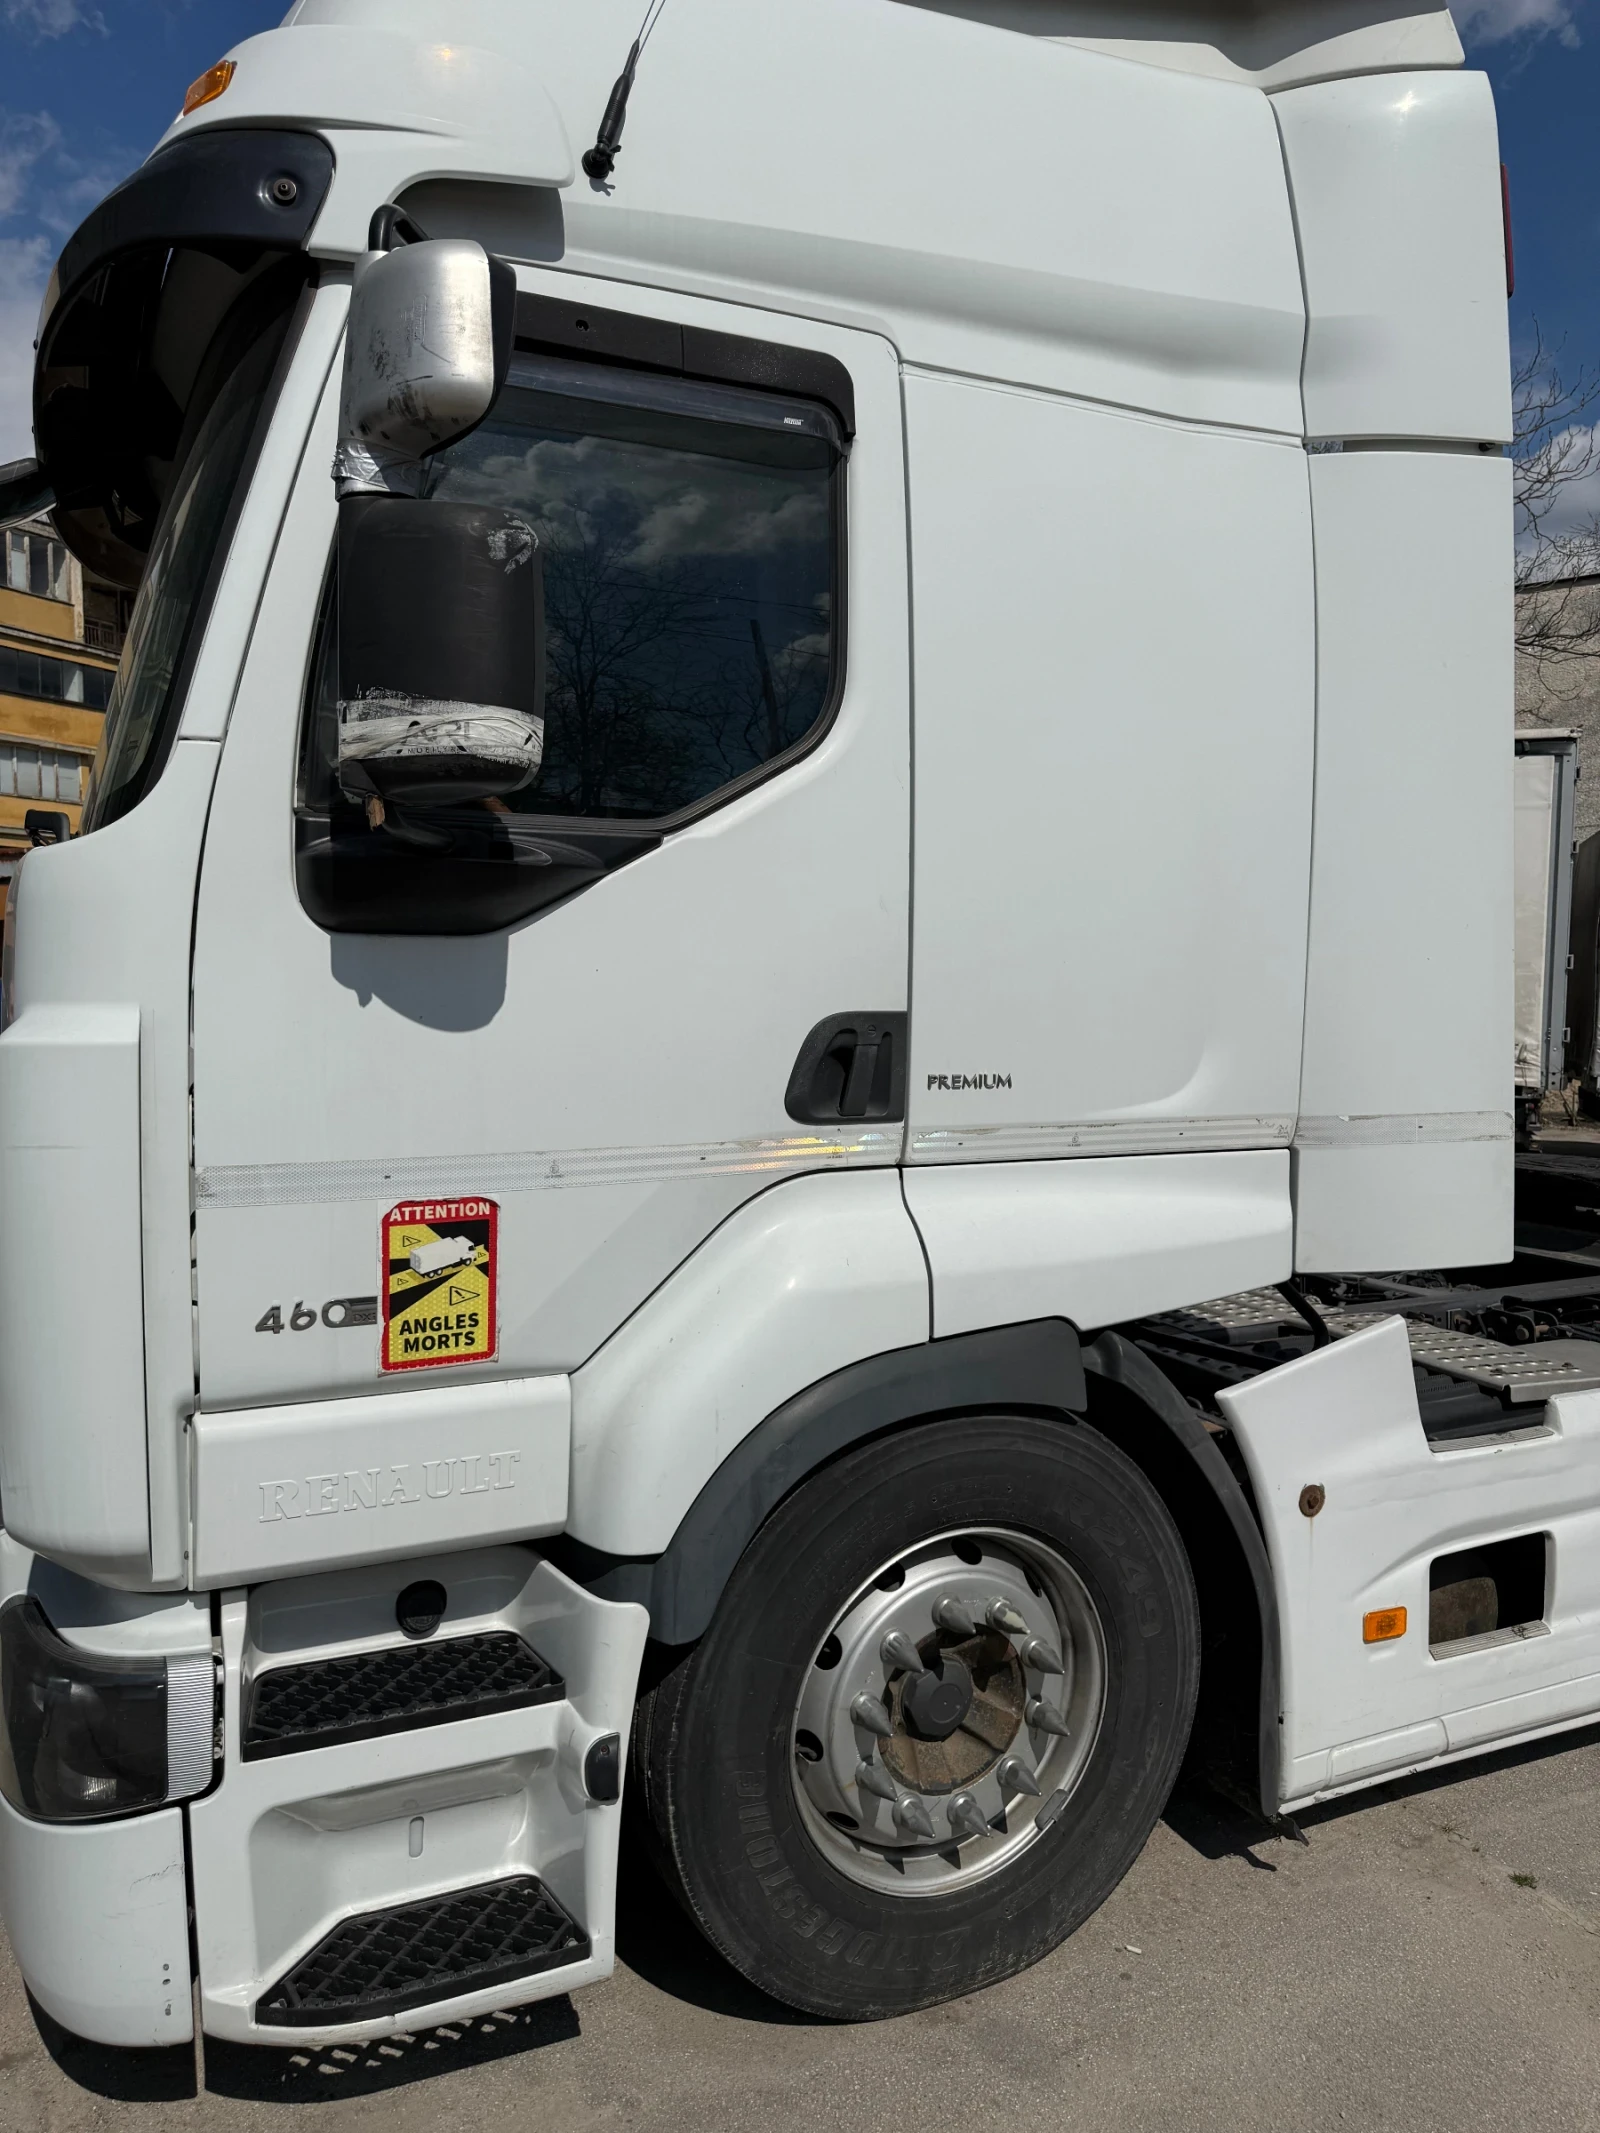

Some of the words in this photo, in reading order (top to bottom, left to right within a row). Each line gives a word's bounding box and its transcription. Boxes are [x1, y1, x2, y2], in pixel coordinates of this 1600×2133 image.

[927, 1073, 1012, 1091] PREMIUM
[389, 1202, 490, 1222] ATTENTION
[255, 1299, 350, 1335] 460
[399, 1312, 479, 1336] ANGLES
[403, 1331, 476, 1354] MORTS
[259, 1450, 521, 1523] RENAULT
[1051, 1484, 1163, 1639] R249
[732, 1769, 972, 1973] BRIDGESTONE
